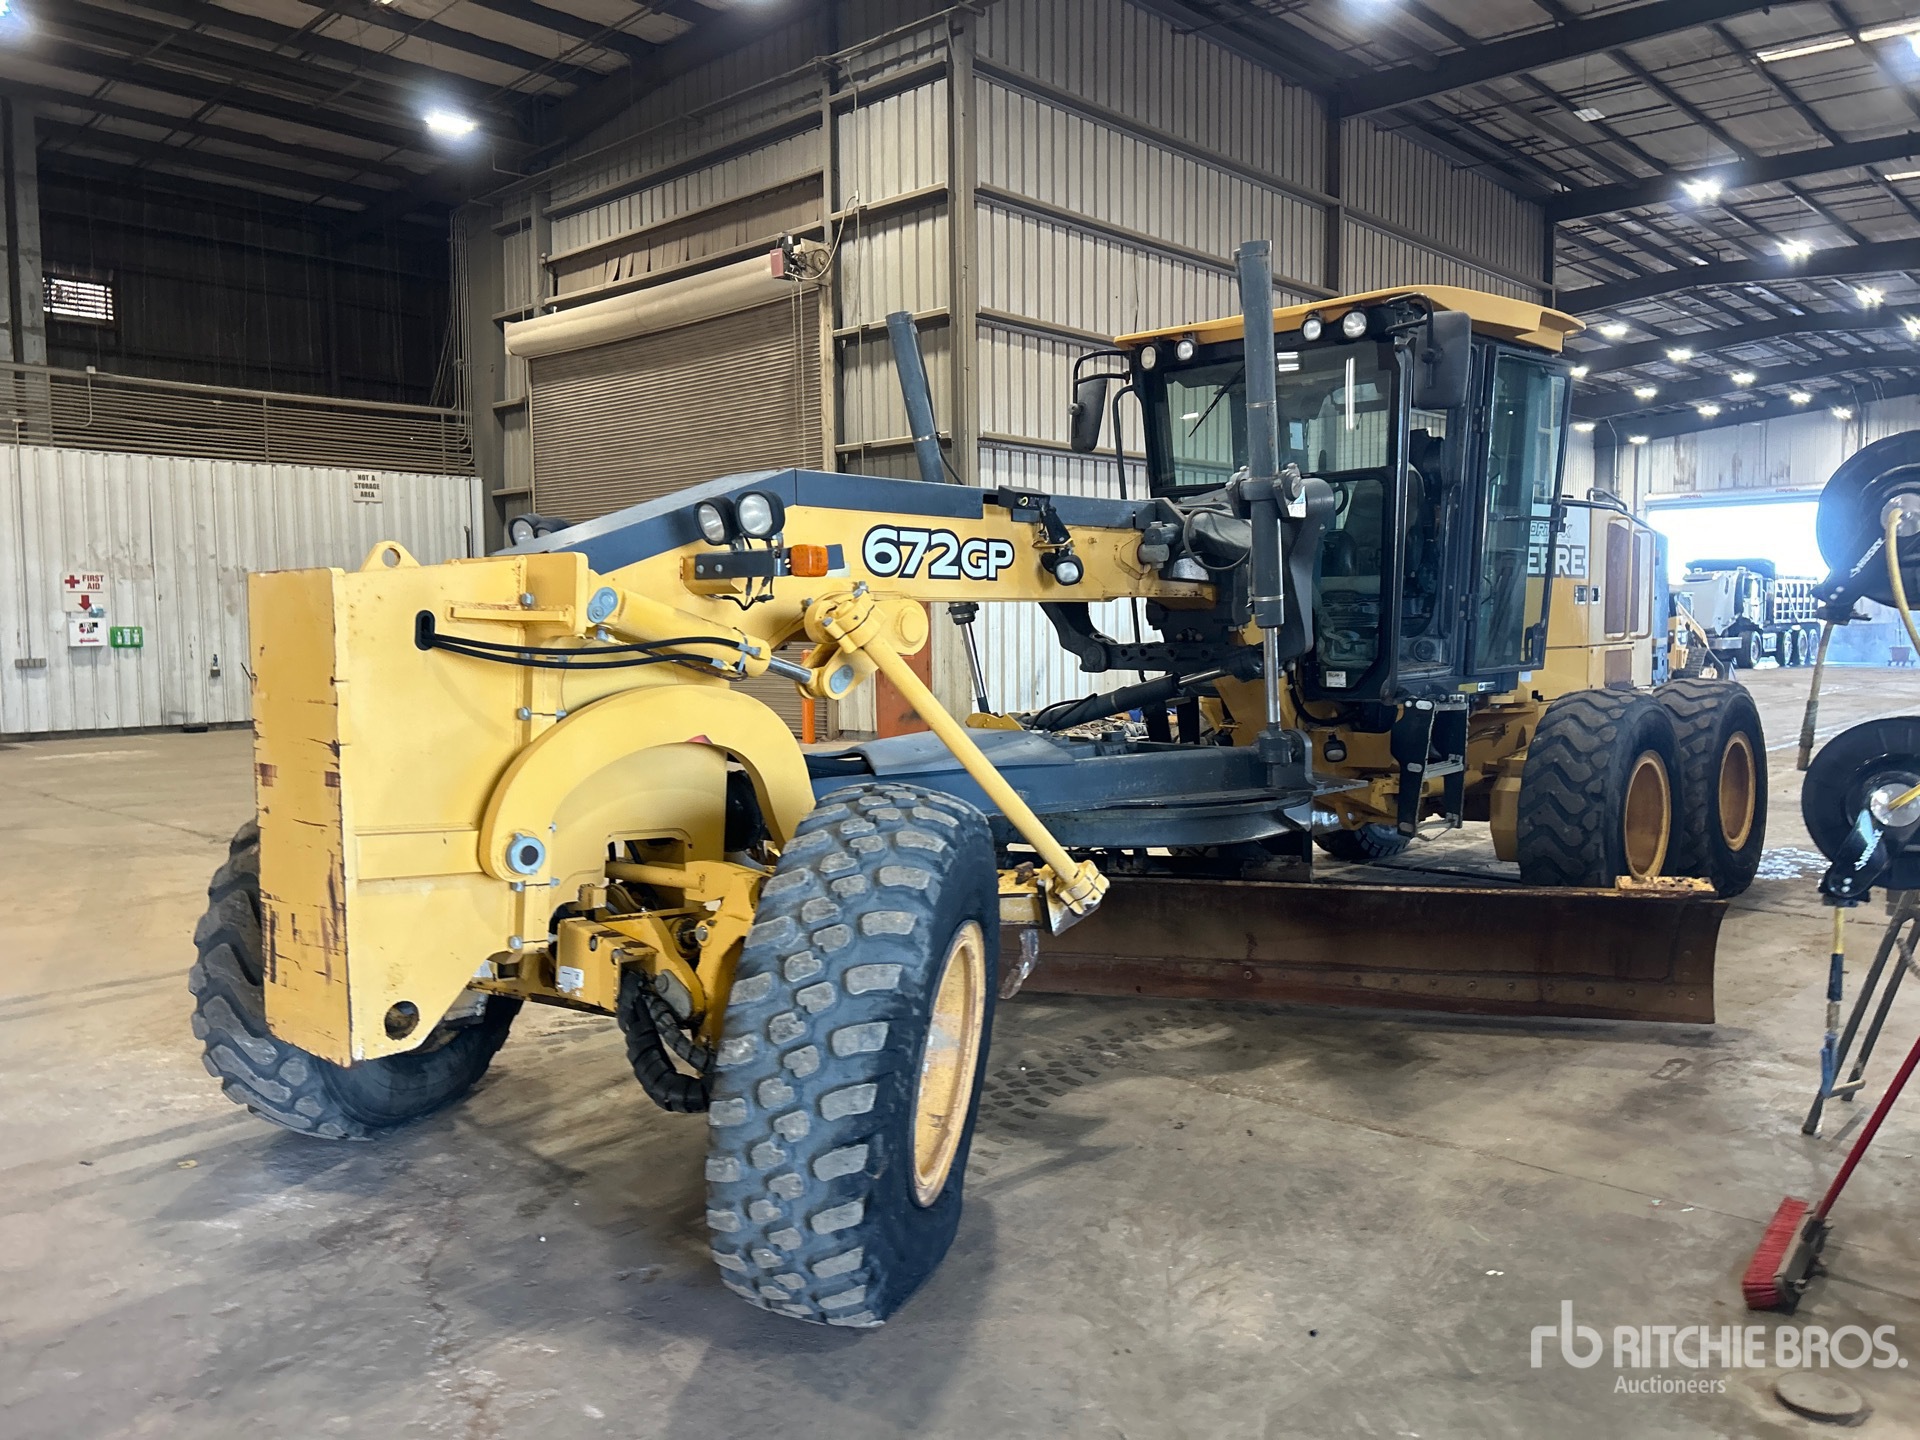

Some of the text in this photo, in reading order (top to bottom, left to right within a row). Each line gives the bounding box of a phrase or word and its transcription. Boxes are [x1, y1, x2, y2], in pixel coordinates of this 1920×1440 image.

[354, 482, 380, 490] STORAGE
[862, 524, 1015, 581] 672GP
[82, 574, 105, 583] FIRST
[87, 582, 101, 590] AID
